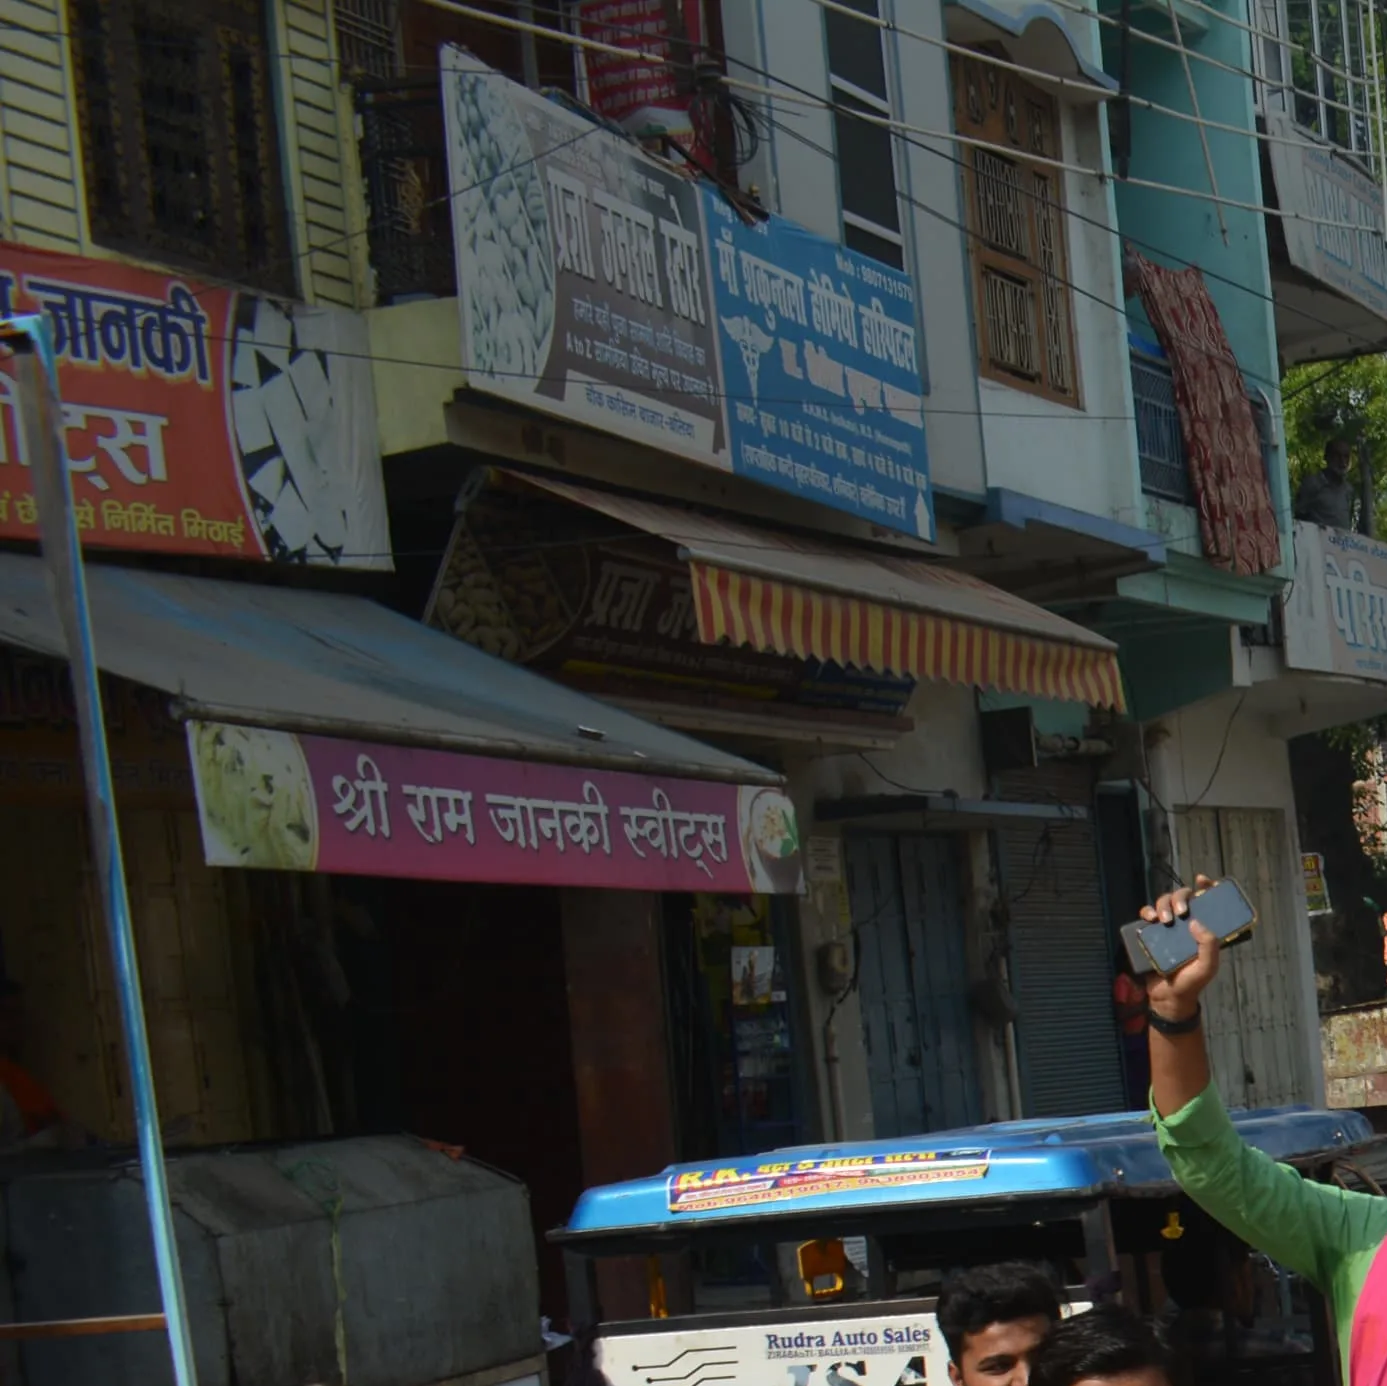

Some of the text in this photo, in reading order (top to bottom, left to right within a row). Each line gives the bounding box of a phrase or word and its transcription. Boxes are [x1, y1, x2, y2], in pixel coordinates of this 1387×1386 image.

[715, 228, 739, 296] माँ
[101, 501, 175, 537] निर्मित
[181, 508, 245, 547] मिठाई
[332, 753, 390, 839] श्री
[402, 783, 476, 846] राम
[485, 780, 611, 855] जानकी
[620, 787, 729, 879] स्वीट्स
[767, 1327, 931, 1349] Rudra Auto Sales
